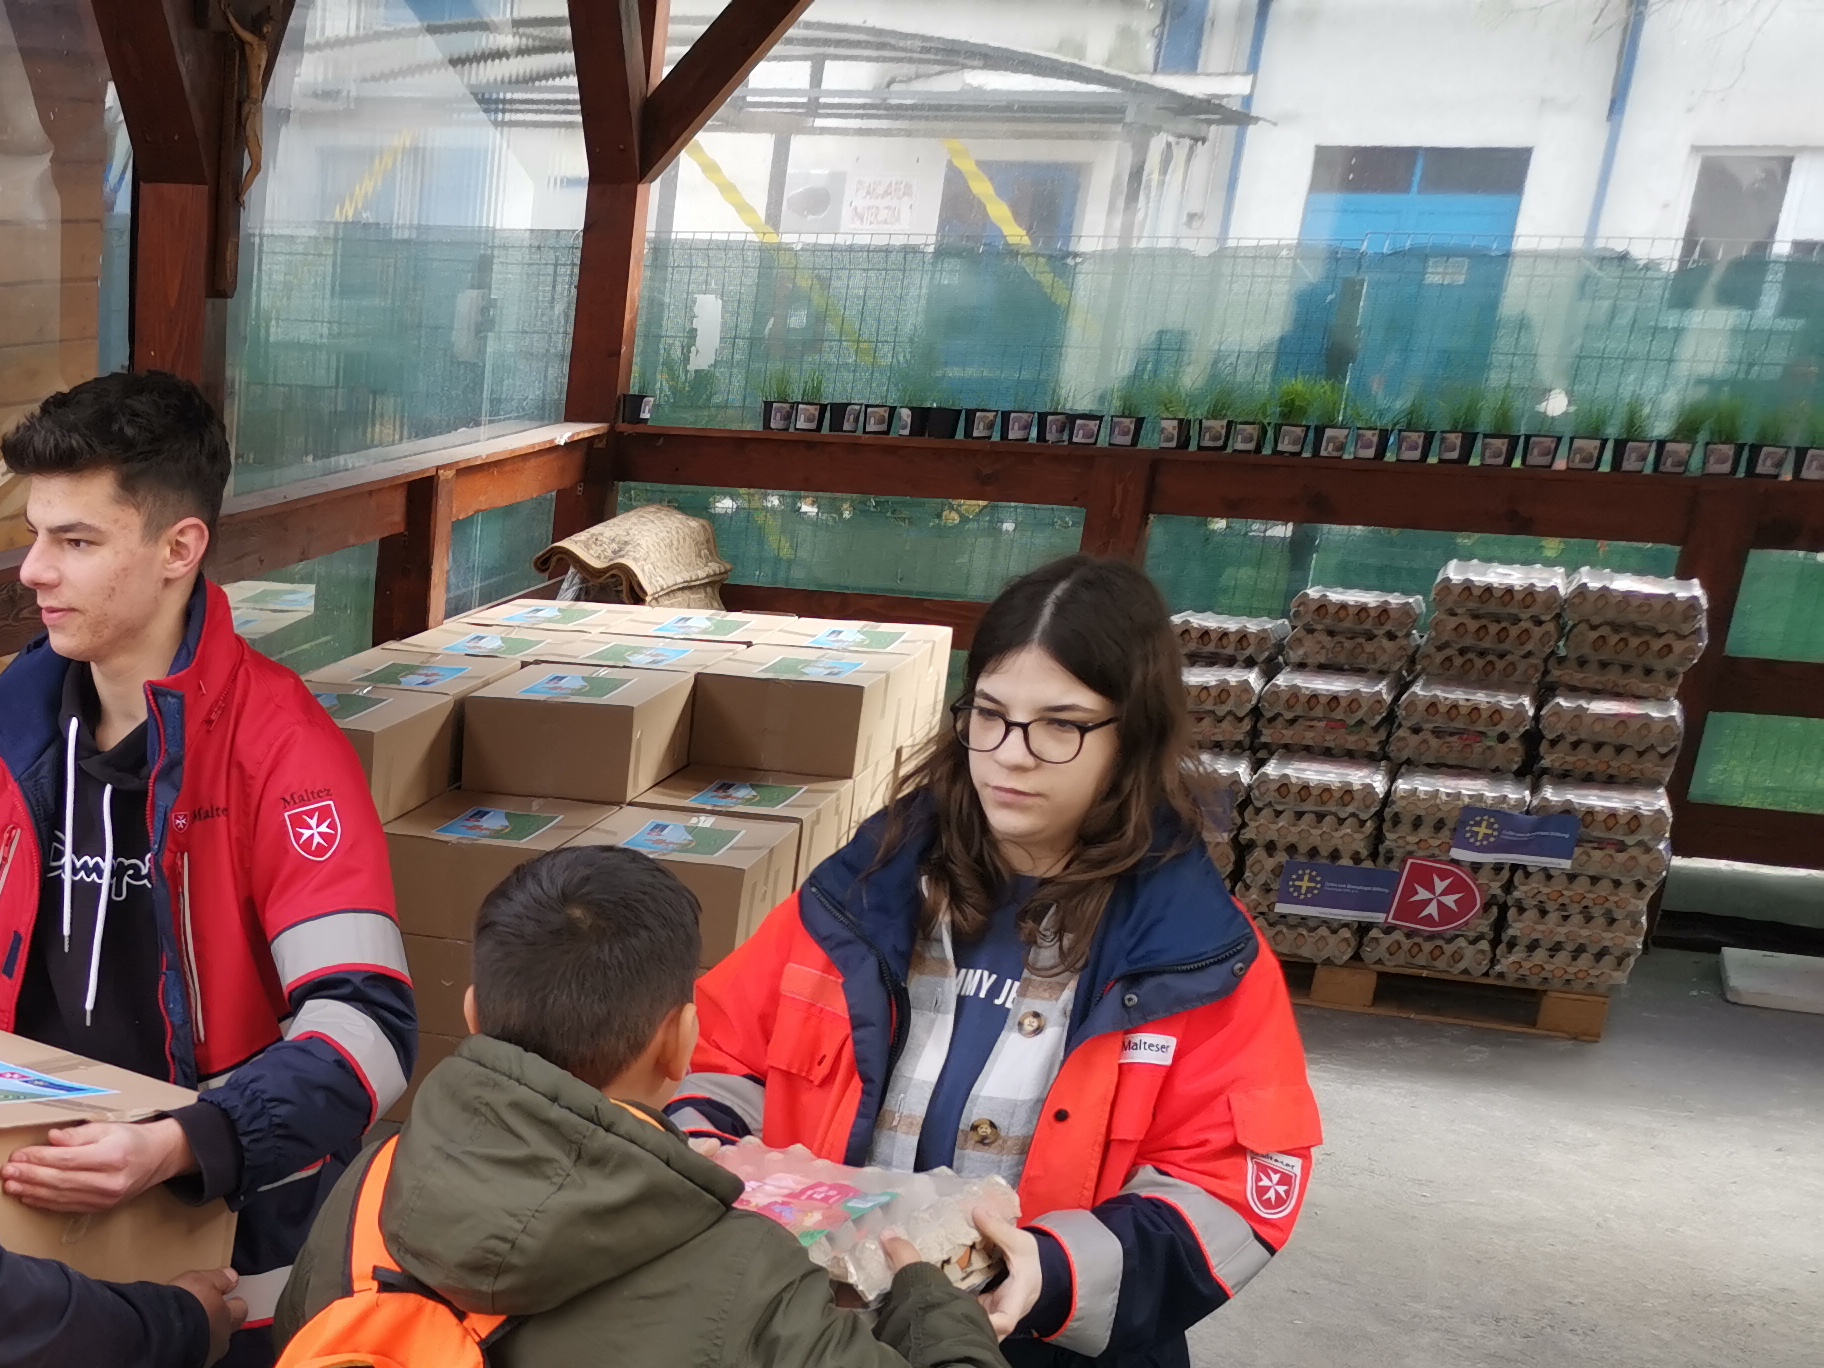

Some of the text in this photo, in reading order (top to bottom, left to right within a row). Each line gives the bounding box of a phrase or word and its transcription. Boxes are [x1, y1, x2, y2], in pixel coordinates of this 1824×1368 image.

[281, 787, 333, 810] Maltez
[191, 805, 229, 824] Malte
[1121, 1038, 1171, 1054] Malteser
